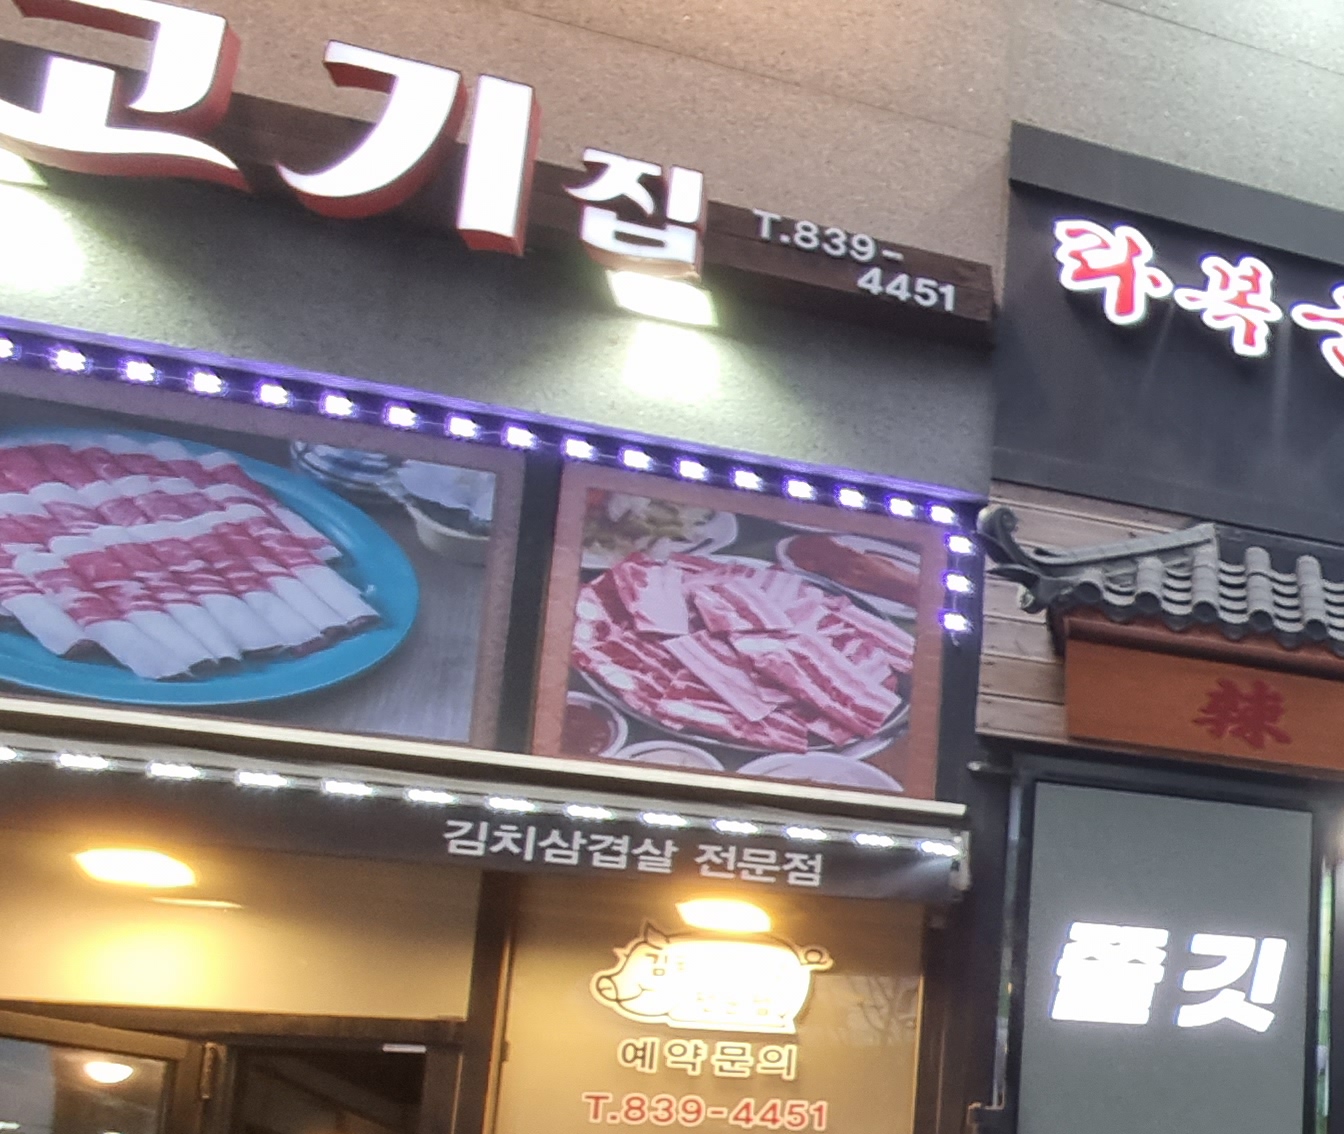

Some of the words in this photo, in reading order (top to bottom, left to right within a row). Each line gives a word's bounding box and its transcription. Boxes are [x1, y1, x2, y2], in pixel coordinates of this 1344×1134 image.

[753, 208, 904, 266] T.839-
[857, 265, 957, 312] 4451
[443, 818, 678, 874] 김치삼겹살
[694, 842, 824, 888] 전문점
[618, 1037, 798, 1082] 예약문의
[583, 1092, 830, 1132] T.839-4451
